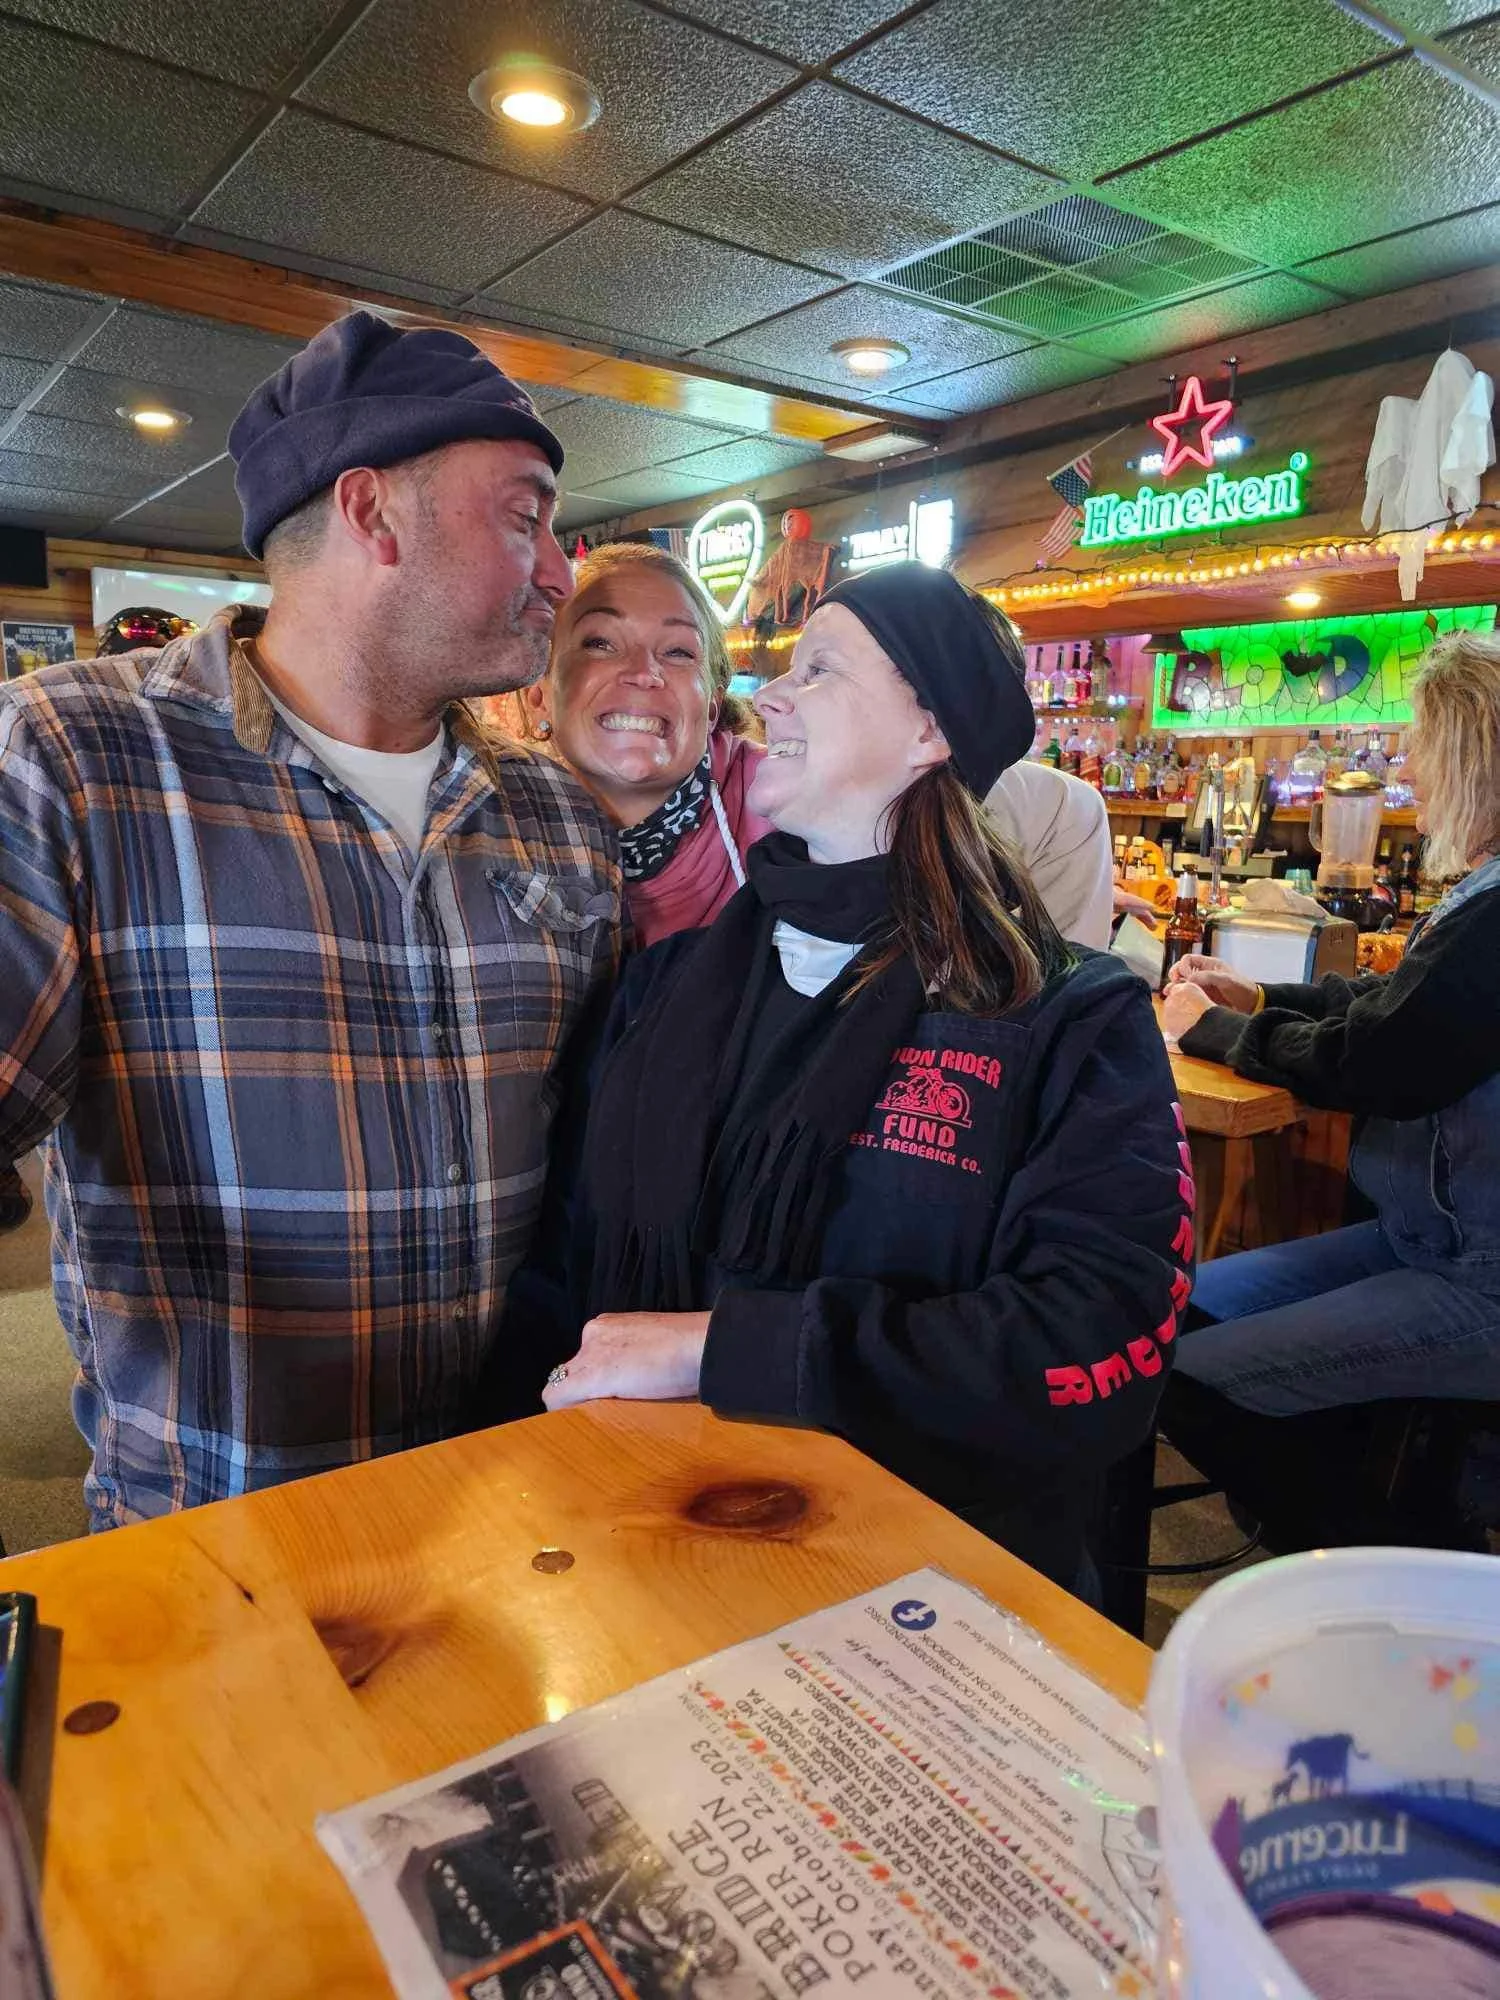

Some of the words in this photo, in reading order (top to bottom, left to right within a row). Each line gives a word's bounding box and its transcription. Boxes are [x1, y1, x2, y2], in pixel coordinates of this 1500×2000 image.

[1080, 471, 1300, 546] Heineken
[891, 1047, 937, 1066] WN
[939, 1049, 1002, 1089] RIDER
[883, 1113, 956, 1148] FUND
[850, 1131, 879, 1148] EST.
[882, 1137, 956, 1166] FREDERICK
[960, 1156, 983, 1175] CO.
[842, 1637, 871, 1653] for
[967, 1630, 987, 1643] for
[860, 1650, 889, 1669] you
[918, 1633, 976, 1677] FACEBOOK
[981, 1641, 1030, 1676] available
[782, 1667, 807, 1684] MD
[879, 1668, 918, 1695] thanks
[970, 1675, 993, 1691] ON
[1023, 1673, 1053, 1694] food
[733, 1698, 759, 1718] MD
[745, 1688, 766, 1704] PA
[912, 1694, 947, 1718] Fund
[987, 1689, 1008, 1704] US
[1047, 1692, 1081, 1715] have
[788, 1707, 811, 1725] PA
[809, 1708, 835, 1727] MD
[942, 1718, 978, 1745] Rider
[1004, 1703, 1059, 1744] FOLLOW
[1073, 1713, 1102, 1733] will
[980, 1726, 1018, 1747] your
[1053, 1742, 1085, 1764] AND
[688, 1738, 744, 1786] 2023
[806, 1747, 848, 1784] RIDGE
[882, 1753, 922, 1786] CLUB
[959, 1774, 982, 1789] All
[975, 1765, 1019, 1800] contact
[736, 1786, 777, 1821] 22,
[827, 1792, 878, 1838] HOUSE
[841, 1782, 880, 1816] BLUE
[699, 1795, 774, 1863] RUN
[897, 1813, 962, 1872] TAVERN
[915, 1784, 1014, 1870] SPORTSMANS
[924, 1815, 961, 1845] PUB
[870, 1837, 915, 1875] CRAB
[1031, 1836, 1053, 1853] for
[767, 1823, 862, 1915] October
[880, 1821, 978, 1912] SPORTSMANS
[910, 1875, 927, 1887] &
[954, 1843, 1042, 1920] JEFFERSON
[1009, 1869, 1042, 1897] MD
[664, 1818, 834, 1999] BRIDGE
[762, 1865, 880, 1983] POKER
[922, 1886, 969, 1929] GRILL
[859, 1915, 951, 2000] unday,
